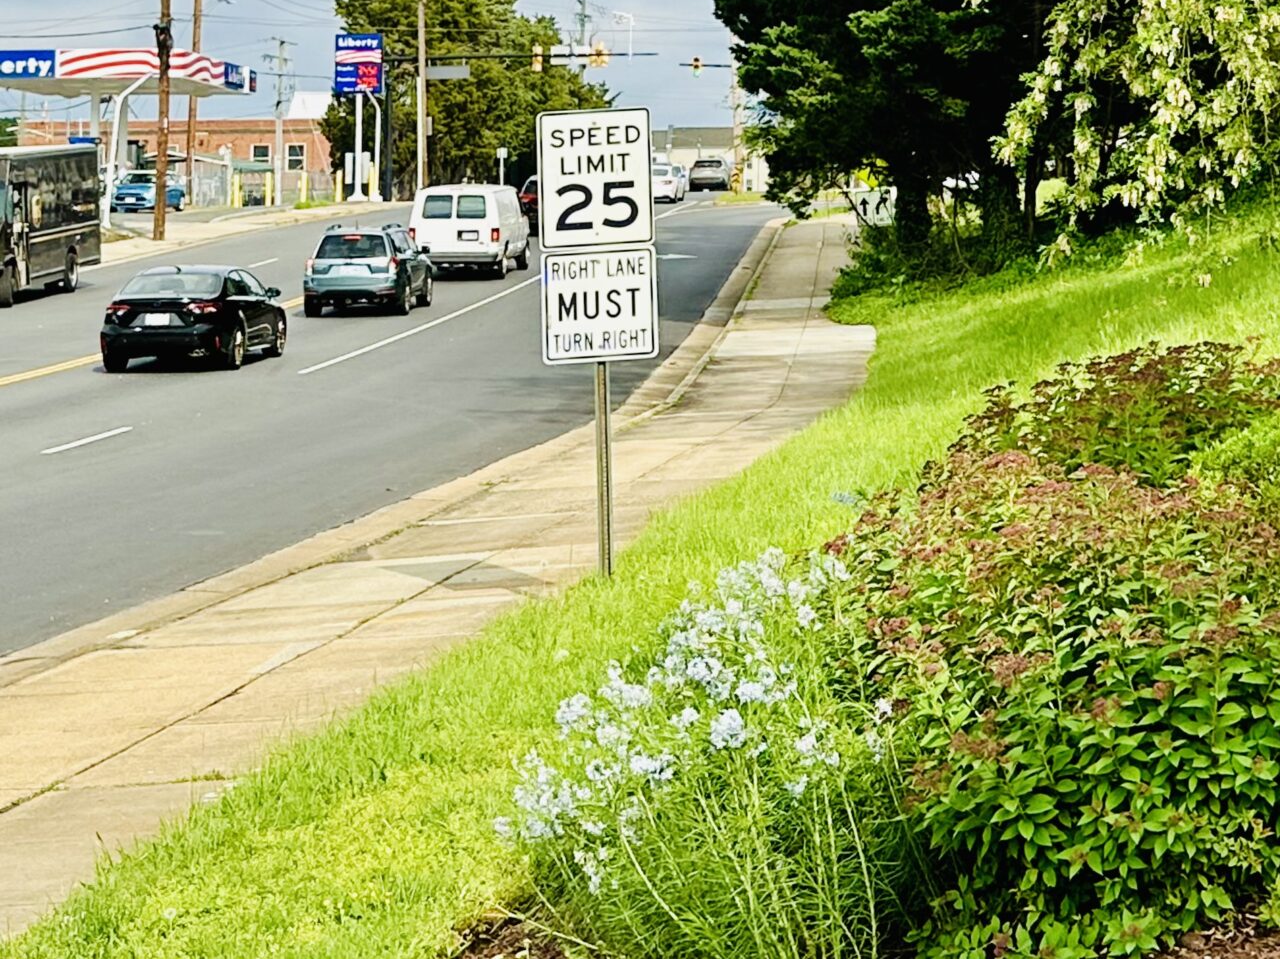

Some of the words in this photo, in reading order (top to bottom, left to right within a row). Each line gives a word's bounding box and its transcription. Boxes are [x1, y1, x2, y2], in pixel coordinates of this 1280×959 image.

[338, 37, 378, 48] Liberty
[550, 125, 641, 148] SPEED
[560, 153, 631, 176] LIMIT
[555, 180, 639, 232] 25
[551, 260, 600, 281] RIGHT
[606, 256, 646, 277] LANE
[558, 288, 641, 322] MUST
[553, 332, 594, 353] TURN
[602, 328, 648, 350] RIGHT
